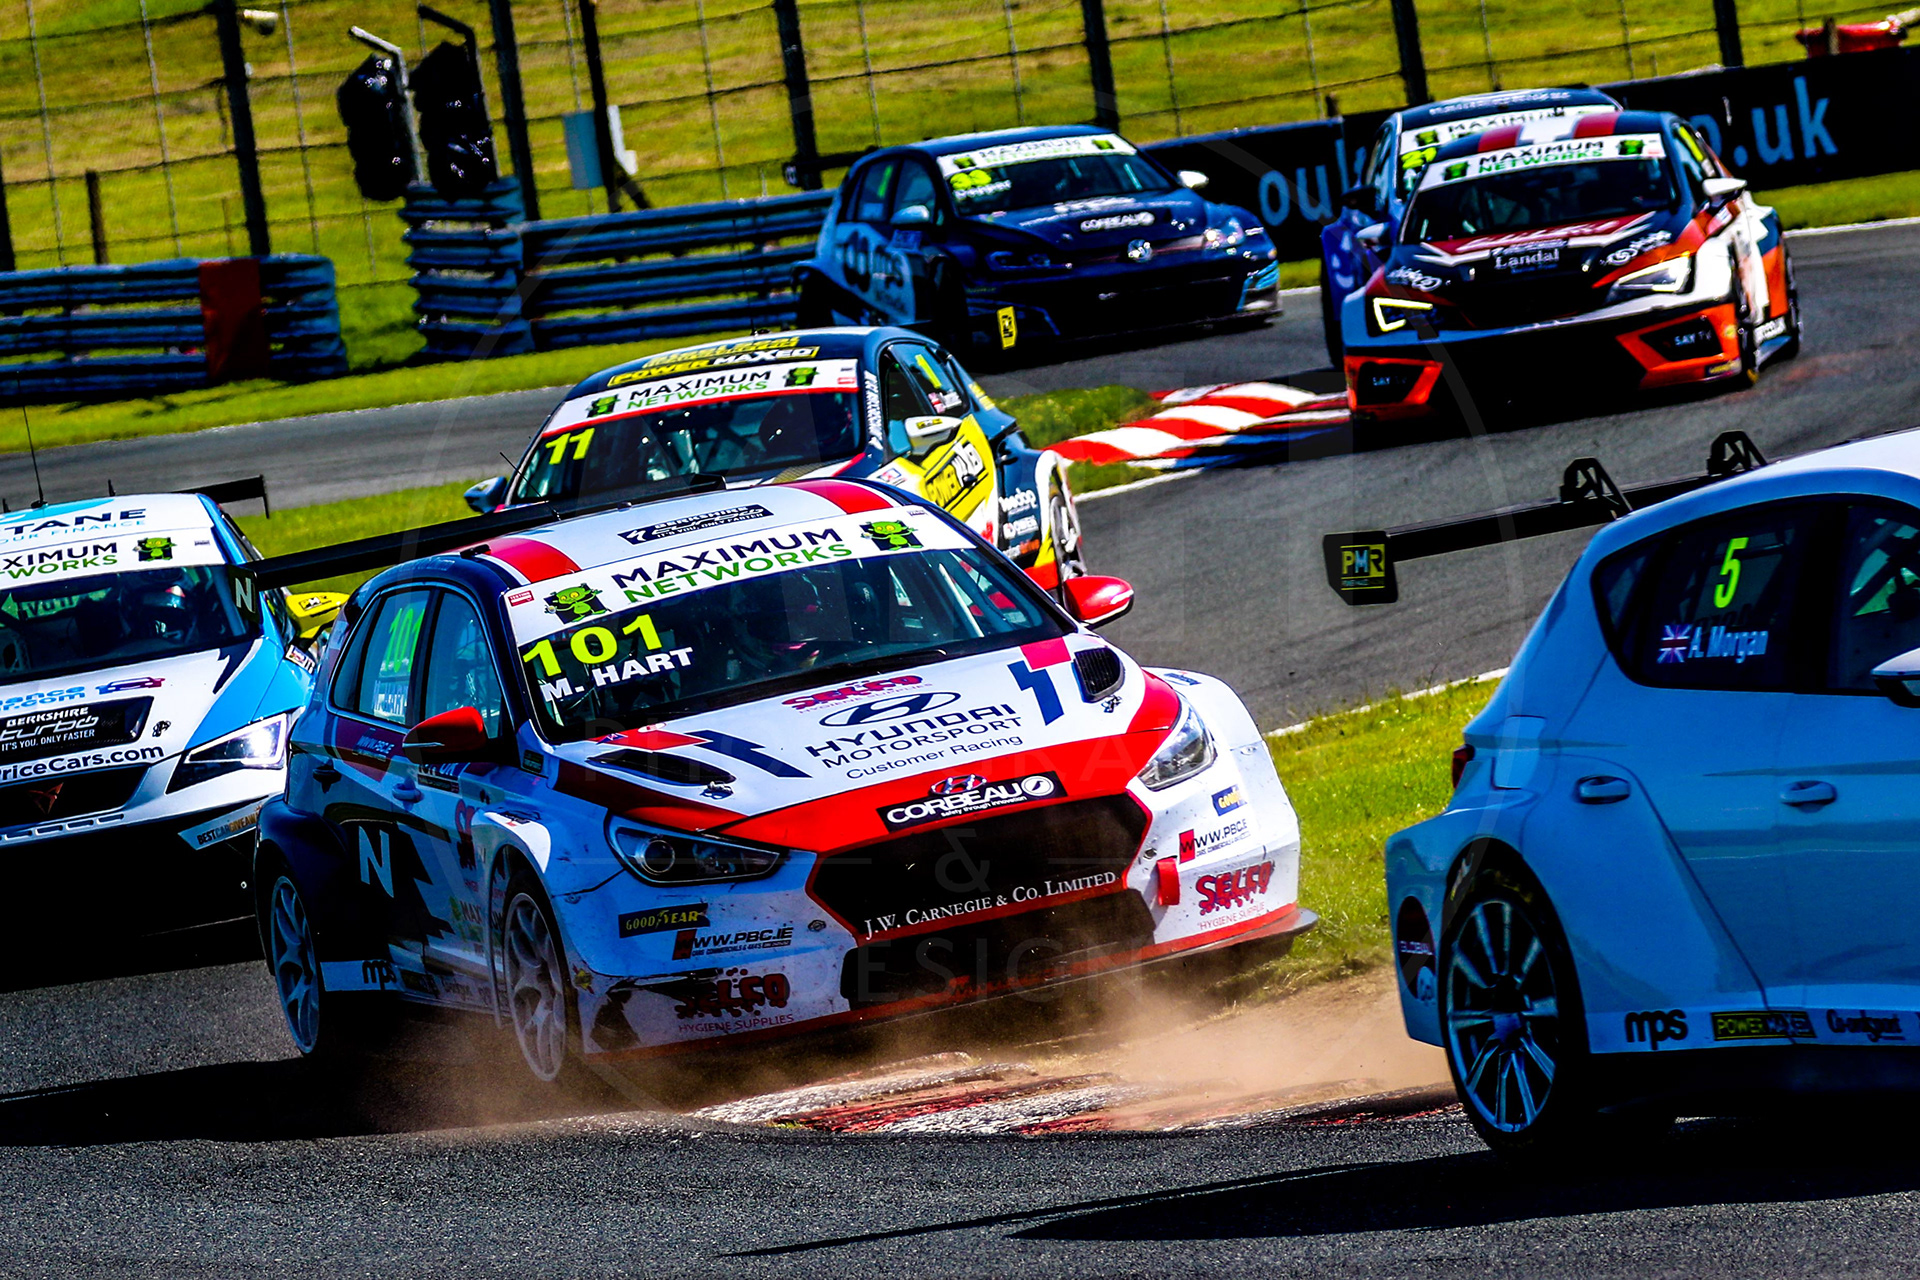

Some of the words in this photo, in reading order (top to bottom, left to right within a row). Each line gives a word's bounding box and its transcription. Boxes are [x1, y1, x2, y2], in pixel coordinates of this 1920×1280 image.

[1478, 150, 1603, 174] NETWORKS
[1479, 140, 1604, 165] MAXIMUM
[1496, 248, 1560, 270] Landal
[612, 360, 710, 385] POWER
[630, 370, 772, 400] MAXIMUM
[627, 380, 768, 410] NETWORKS
[545, 427, 596, 466] 11
[51, 521, 146, 536] FINANCE
[611, 528, 842, 589] MAXIMUM
[622, 541, 853, 603] NETWORKS
[1341, 548, 1384, 575] PMR
[1715, 536, 1749, 608] 5
[235, 577, 256, 614] N
[522, 613, 663, 677] 101
[1706, 625, 1769, 664] Morgan
[539, 677, 585, 703] M.
[591, 646, 694, 687] HART
[6, 706, 90, 728] BERKSHIRE
[804, 703, 1021, 758] HYUNDAI
[1, 742, 18, 751] IT'S
[41, 733, 62, 745] ONLY
[63, 729, 96, 741] FASTER
[821, 716, 1023, 769] MOTORSPORT
[845, 747, 946, 780] Customer
[951, 732, 1023, 755] Racing
[886, 782, 1023, 824] CORBEAU
[940, 807, 963, 818] safety
[963, 802, 991, 814] through
[993, 795, 1028, 808] innovation
[358, 825, 394, 898] N
[863, 911, 901, 940] J.W.
[905, 895, 993, 926] CARNEGIE
[996, 894, 1008, 907] &
[1046, 870, 1117, 897] LIMITED
[1195, 861, 1276, 916] SELCO
[625, 909, 700, 931] GOODYEAR
[677, 926, 795, 953] WWW.PBC.IE
[679, 1021, 732, 1033] HYGIENE
[734, 1013, 795, 1031] SUPPLIES
[1625, 1009, 1689, 1051] mps
